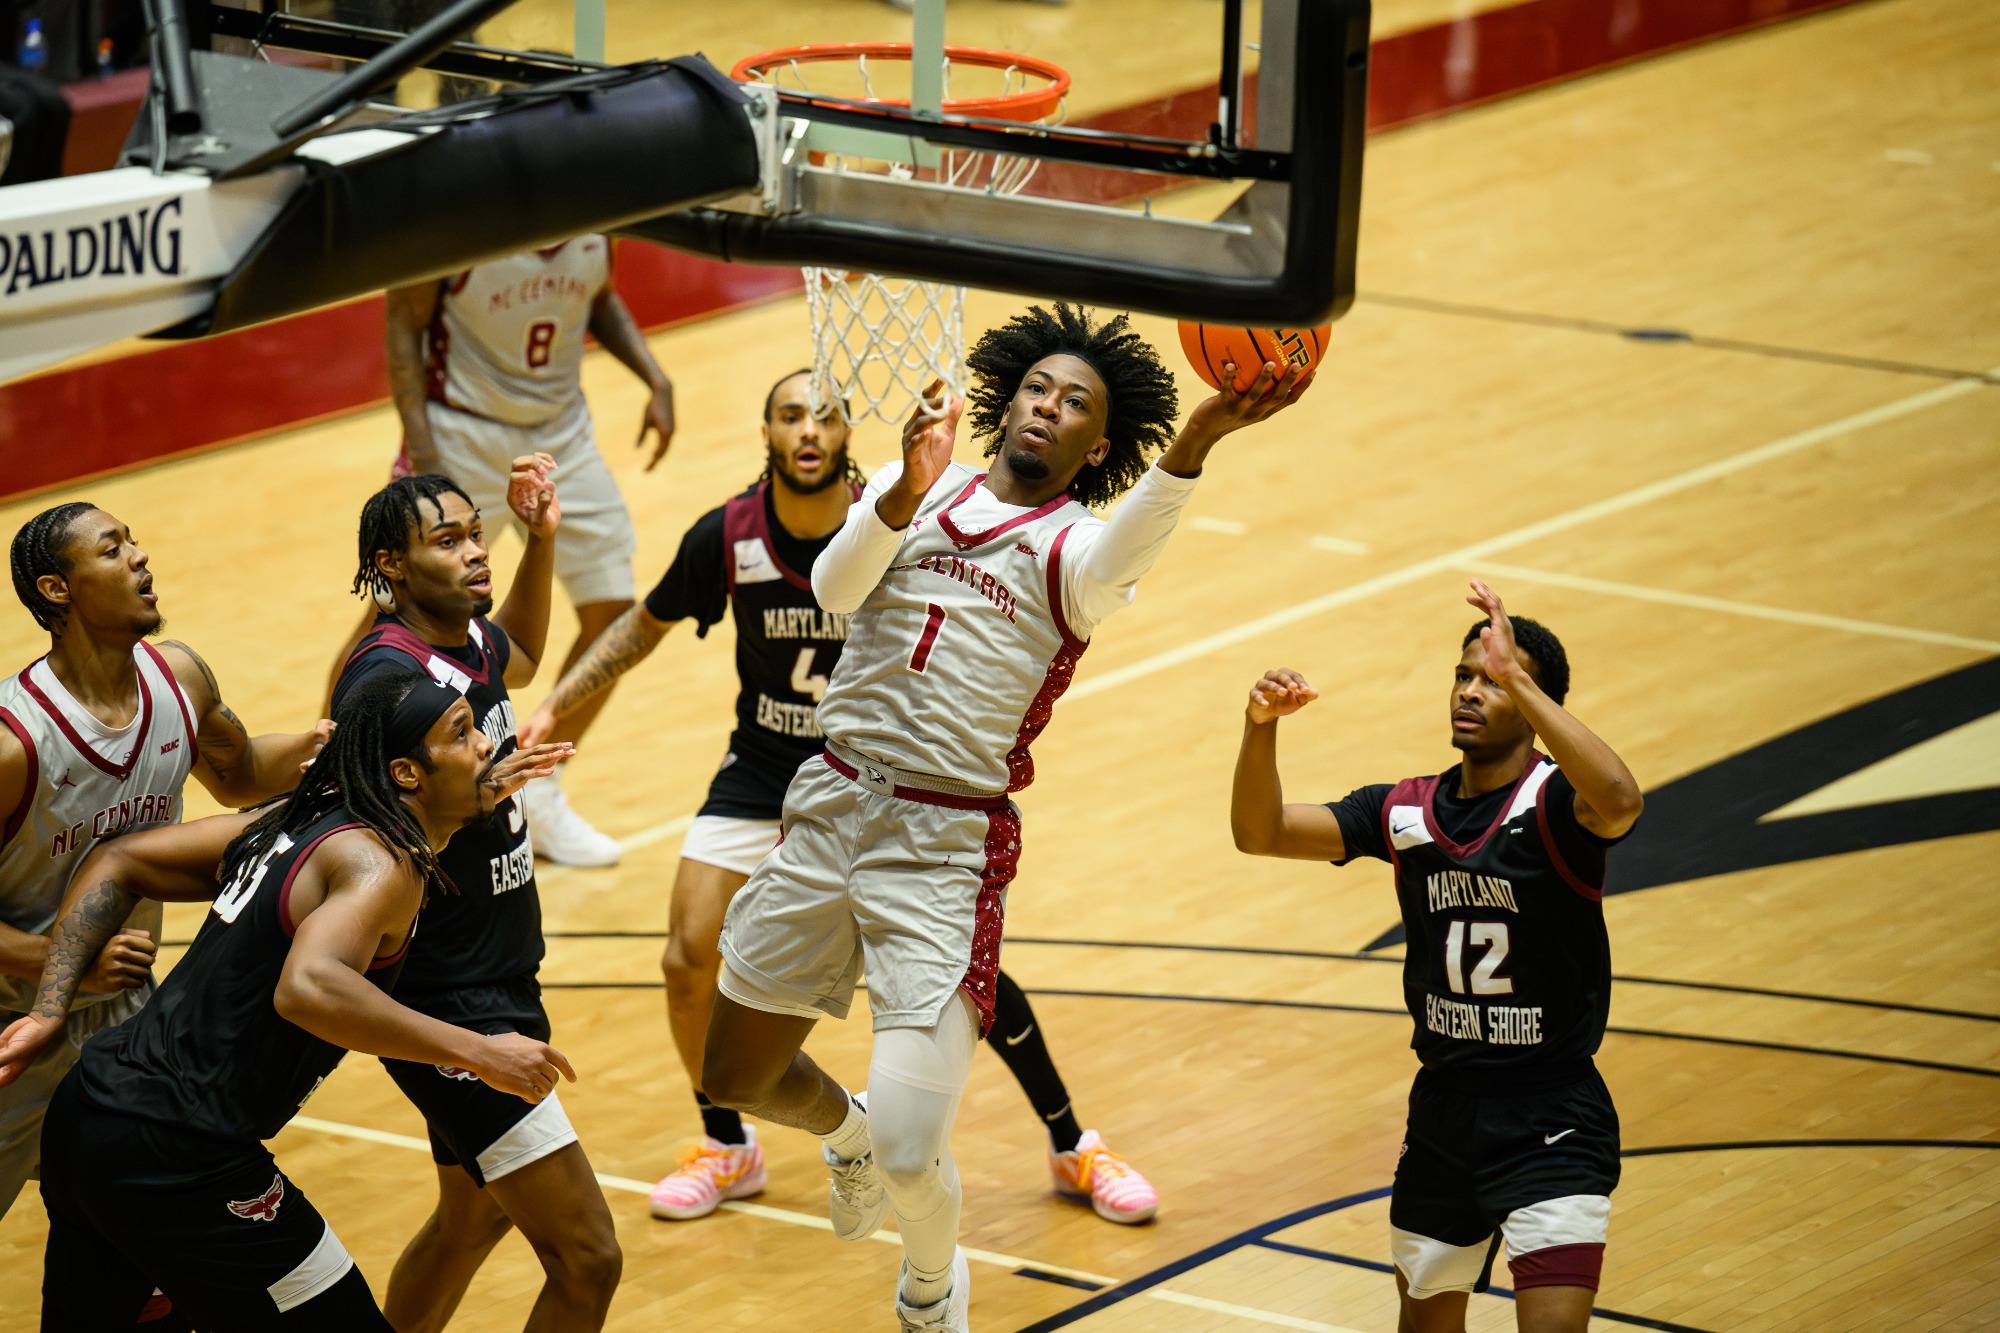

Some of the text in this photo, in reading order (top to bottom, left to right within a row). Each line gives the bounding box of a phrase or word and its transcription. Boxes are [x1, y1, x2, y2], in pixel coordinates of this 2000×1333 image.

[525, 319, 558, 371] 8
[905, 600, 948, 677] 1
[790, 647, 831, 703] 4
[50, 794, 172, 858] NC CENTRAL
[1427, 870, 1519, 913] MARYLAND
[1444, 919, 1515, 997] 12
[1426, 993, 1543, 1046] EASTERN SHORE
